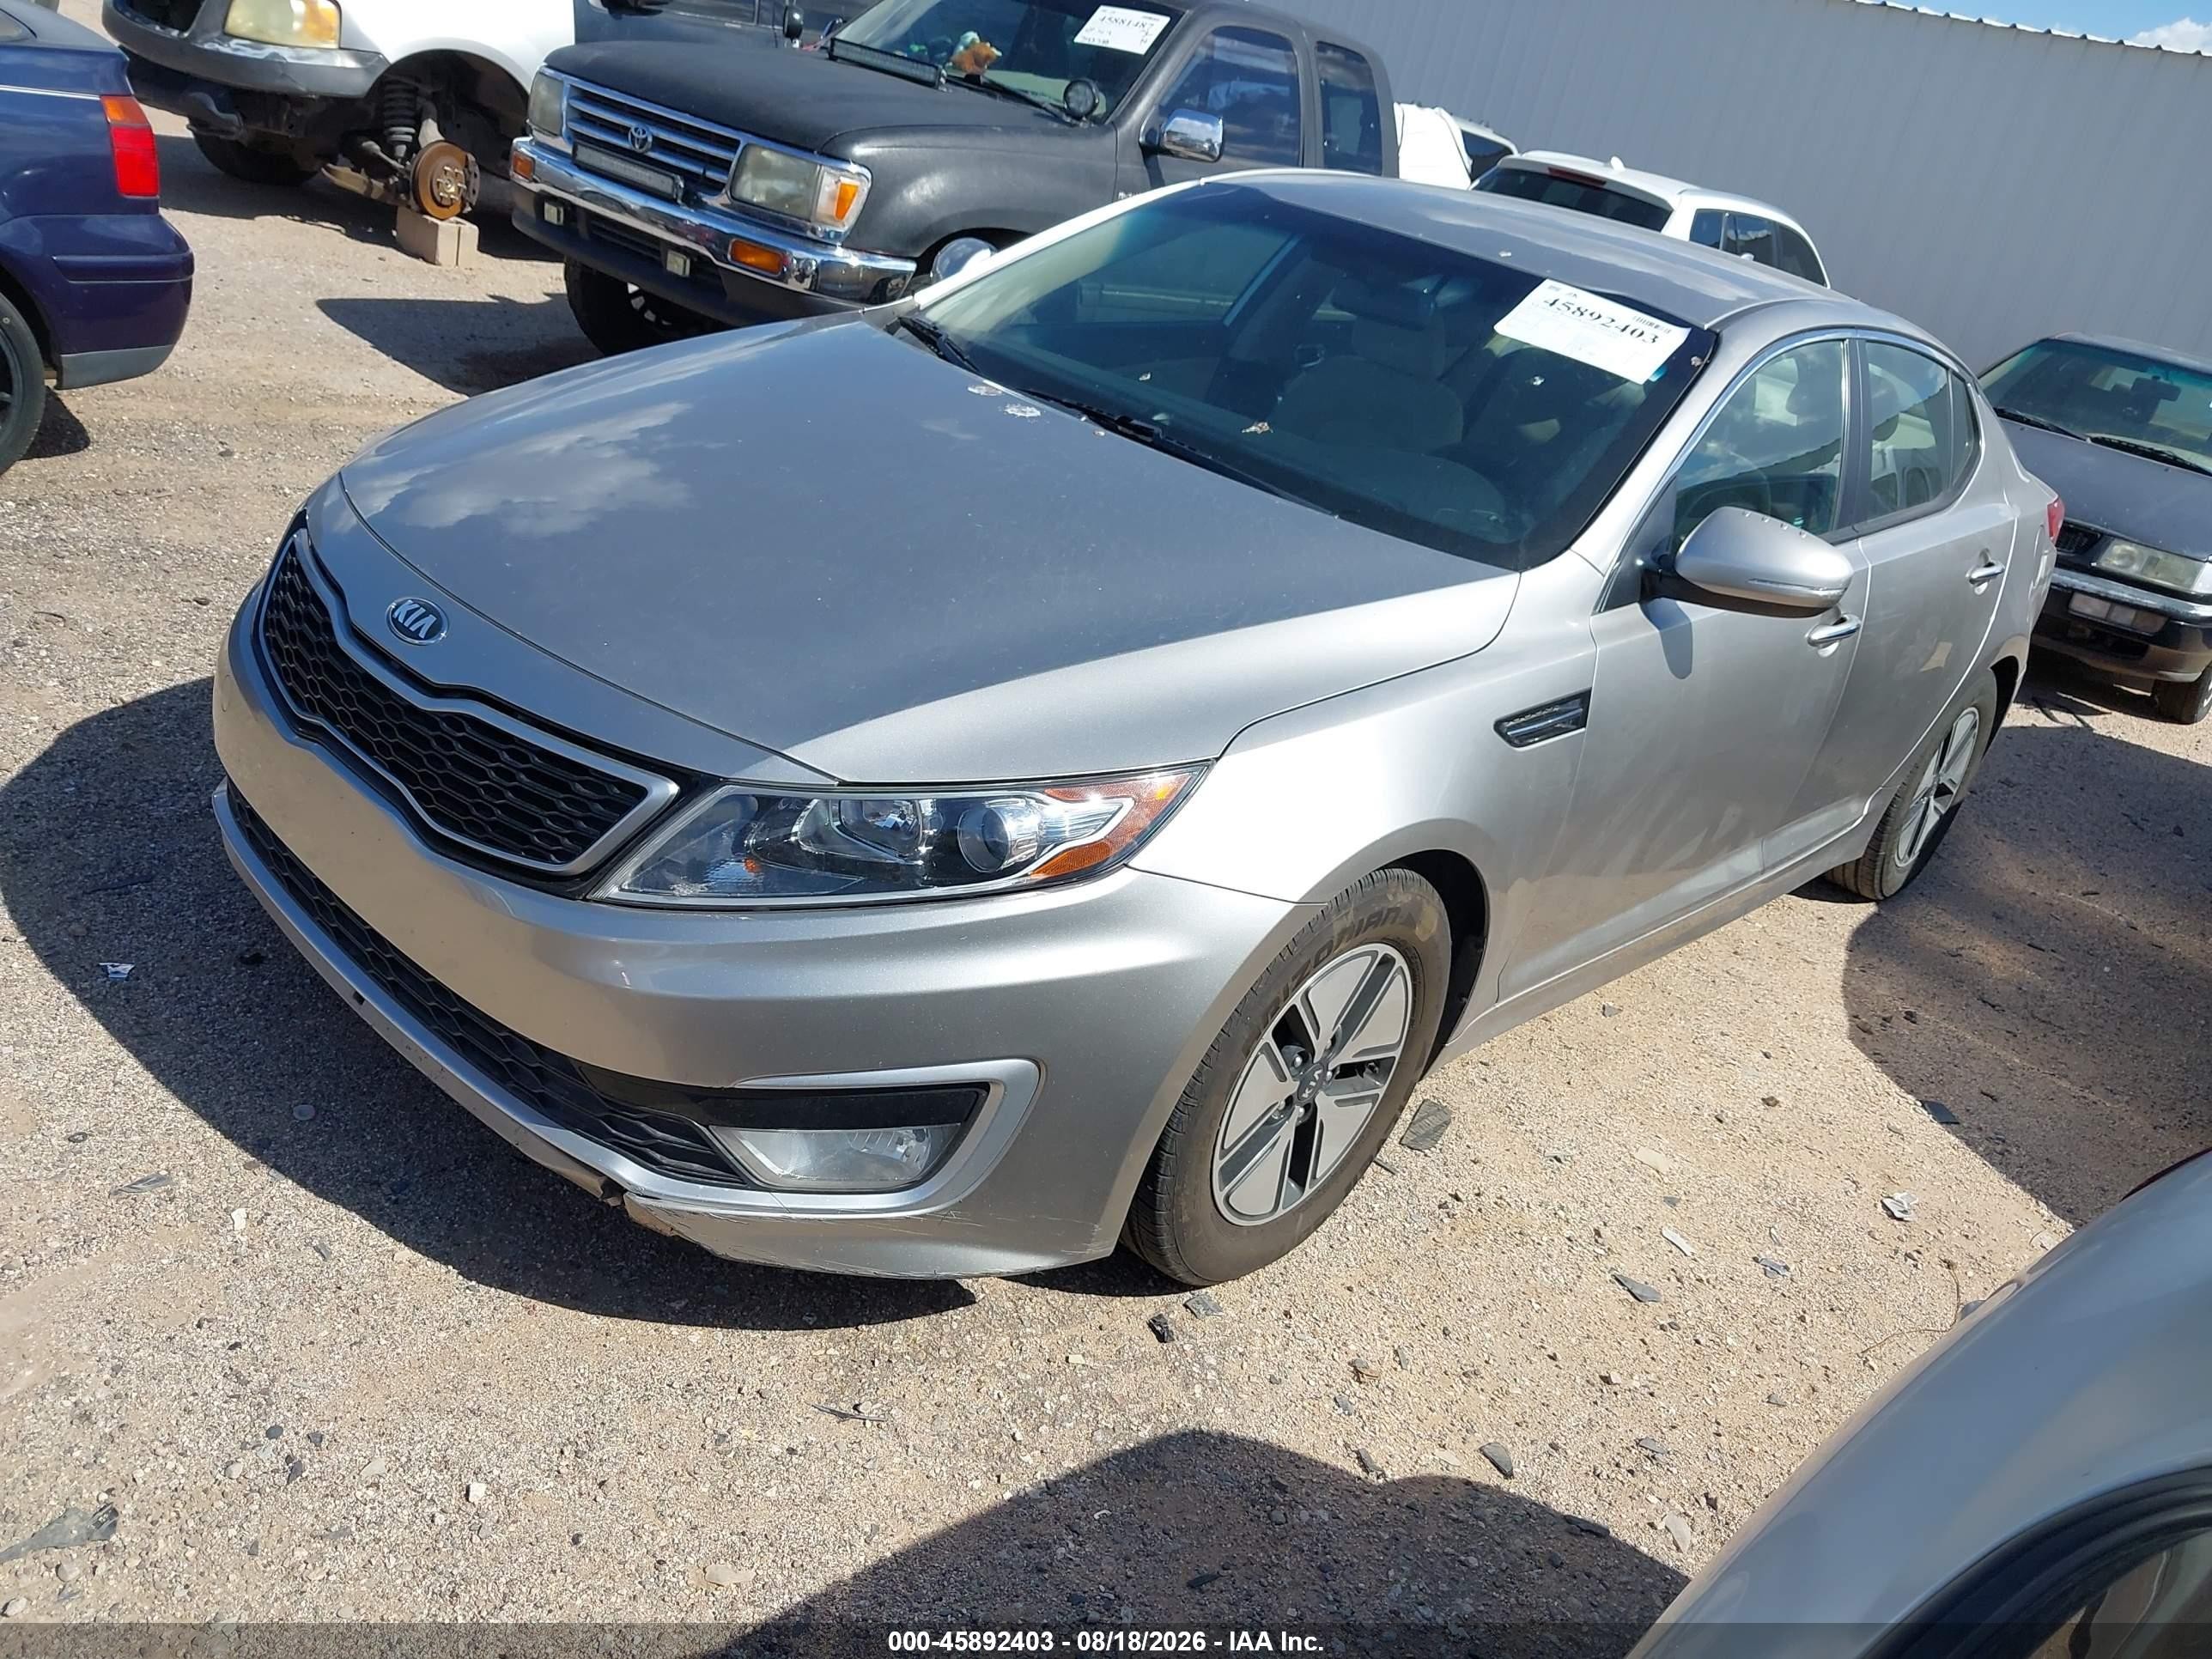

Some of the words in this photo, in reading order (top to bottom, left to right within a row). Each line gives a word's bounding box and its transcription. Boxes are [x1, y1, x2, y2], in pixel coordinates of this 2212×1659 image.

[1543, 298, 1659, 343] 45892403
[392, 599, 437, 639] KIA
[1301, 1068, 1323, 1099] KIA
